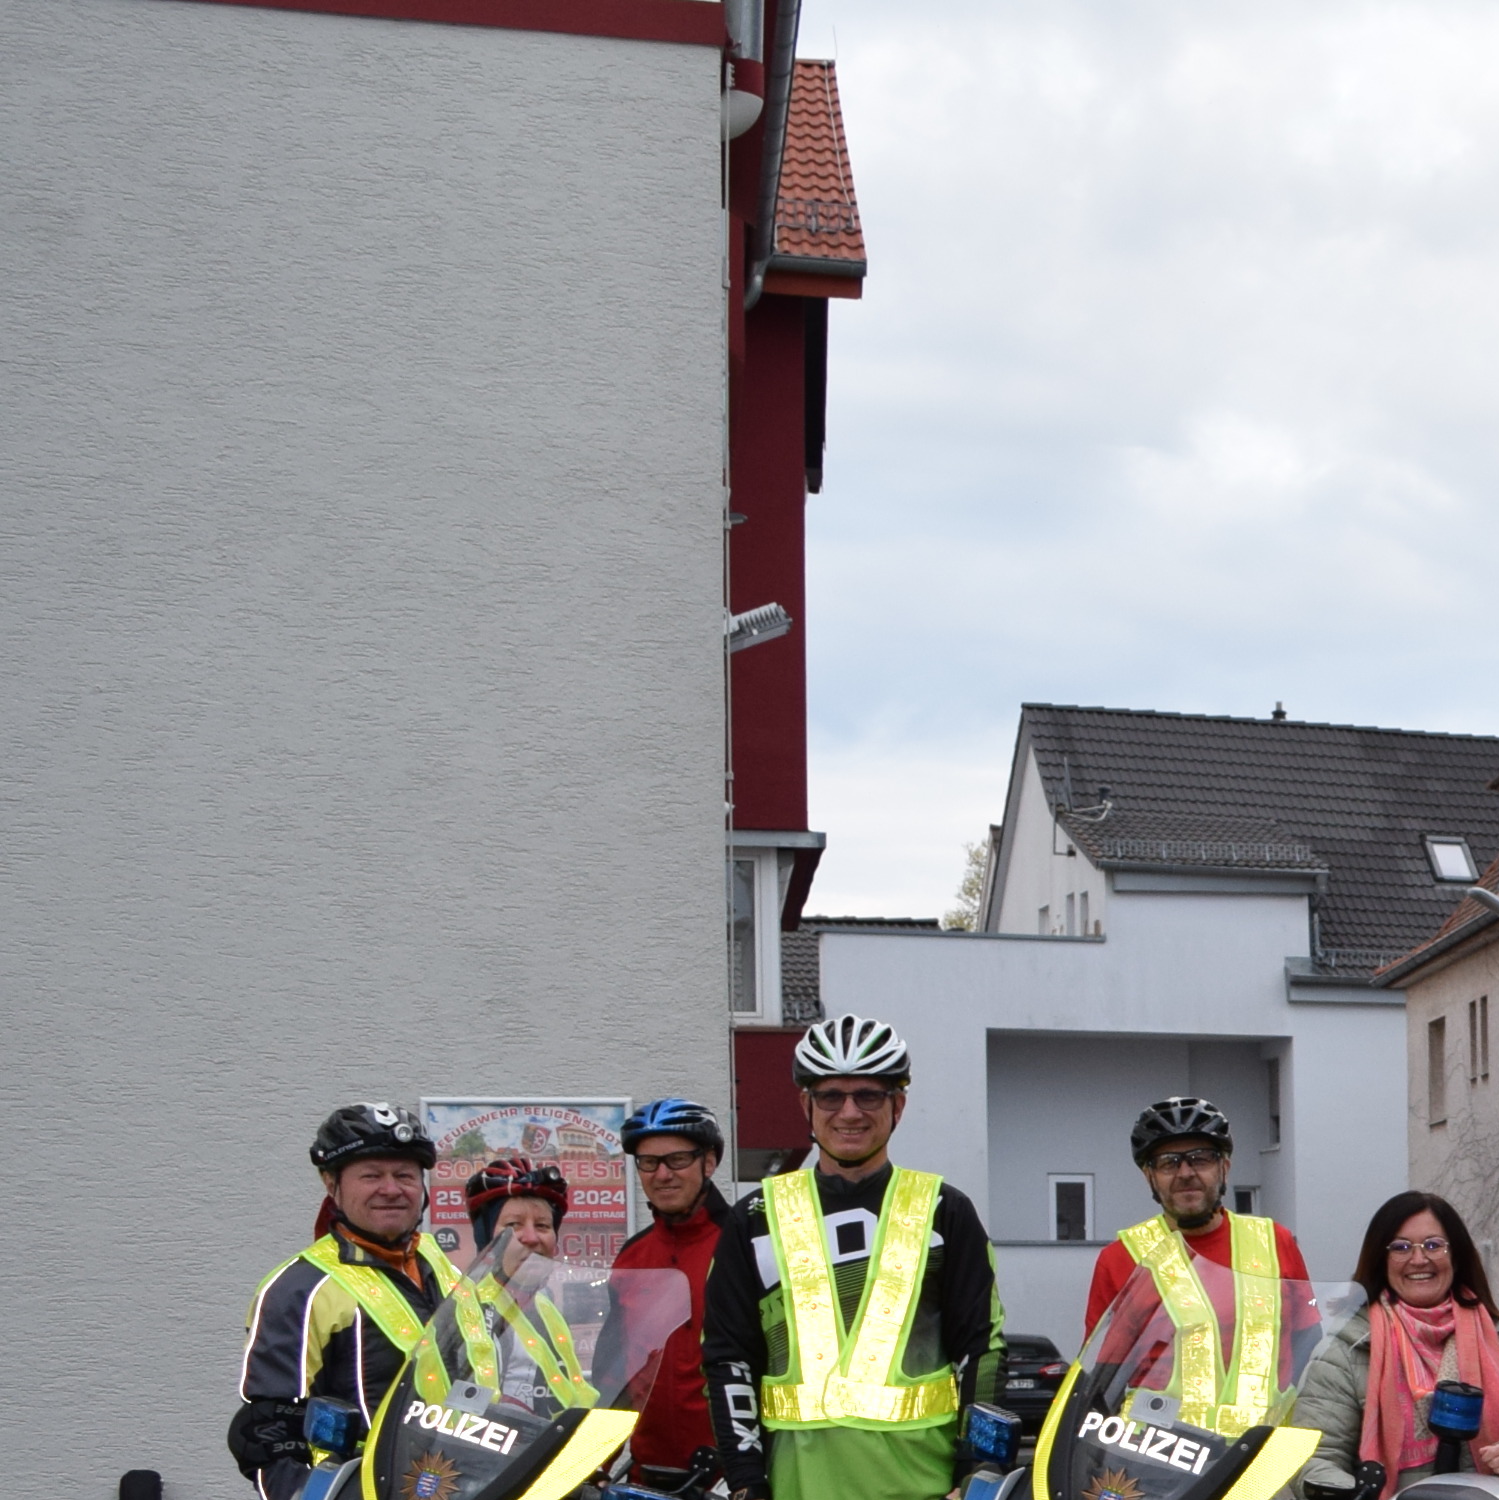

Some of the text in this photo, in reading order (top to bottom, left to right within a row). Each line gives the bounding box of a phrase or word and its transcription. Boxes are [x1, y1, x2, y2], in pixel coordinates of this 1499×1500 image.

[437, 1106, 622, 1149] FEUERWEHR SELIGENSTADT
[573, 1190, 625, 1205] 2024
[437, 1233, 456, 1243] SA
[403, 1400, 518, 1455] POLIZEI
[1078, 1411, 1211, 1475] POLIZEI
